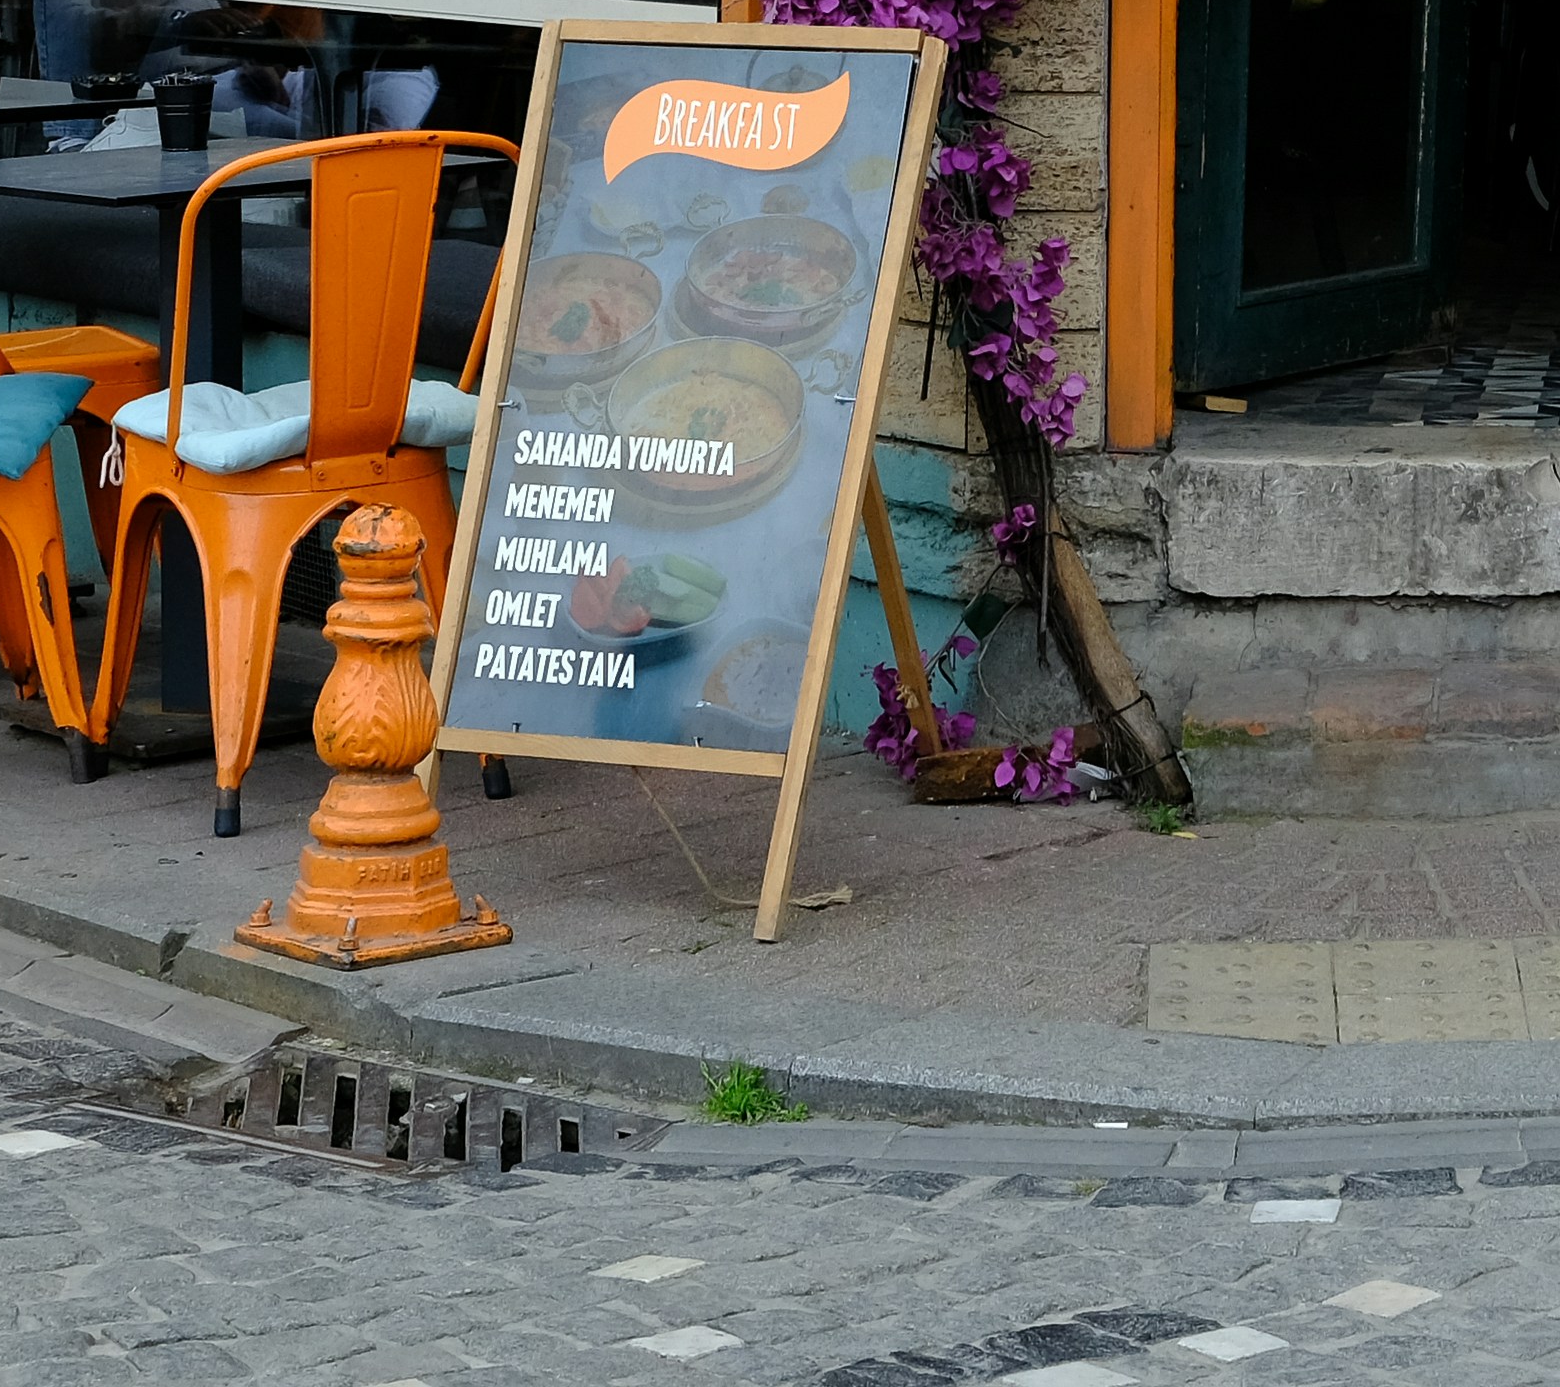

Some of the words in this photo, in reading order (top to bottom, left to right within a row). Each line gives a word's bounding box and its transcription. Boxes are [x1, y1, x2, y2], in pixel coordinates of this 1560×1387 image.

[513, 429, 622, 471] SAHANDA
[627, 435, 735, 477] YUMURTA
[503, 482, 616, 524] MENEMEN
[493, 535, 609, 578] MUHLAMA
[485, 588, 563, 629] OMLET
[473, 643, 577, 685] PATATES
[577, 650, 636, 690] TAVA
